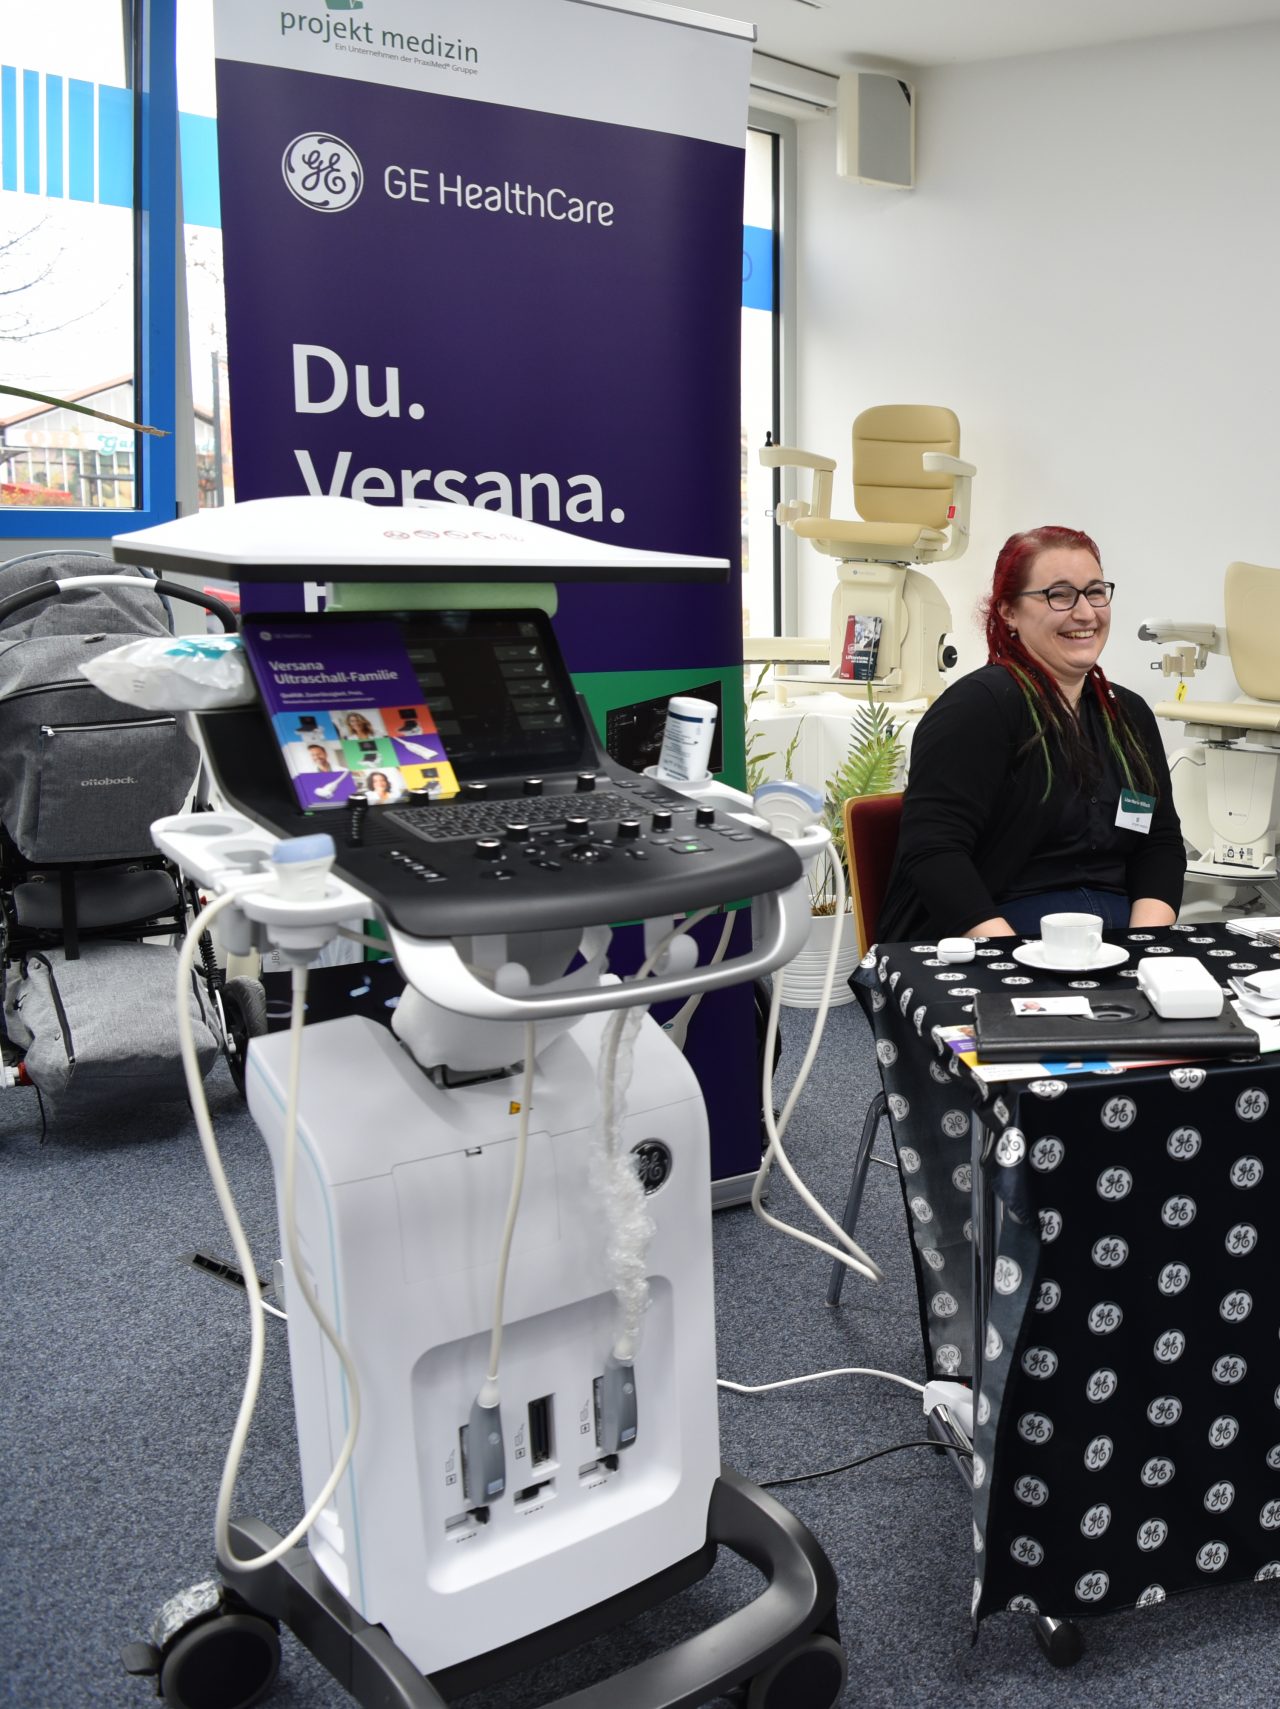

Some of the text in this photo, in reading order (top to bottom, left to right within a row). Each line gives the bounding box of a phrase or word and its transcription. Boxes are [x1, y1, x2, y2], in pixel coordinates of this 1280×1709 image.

[280, 10, 478, 63] projekt medizin
[335, 43, 347, 51] Ein
[349, 45, 399, 61] Unternehmen
[400, 54, 412, 63] der
[452, 64, 478, 75] Gruppe
[383, 165, 614, 227] GE HealthCare
[292, 343, 425, 420] Du.
[293, 449, 626, 524] Versana.
[268, 661, 324, 671] Versana
[274, 669, 399, 684] Ultraschall-Familie
